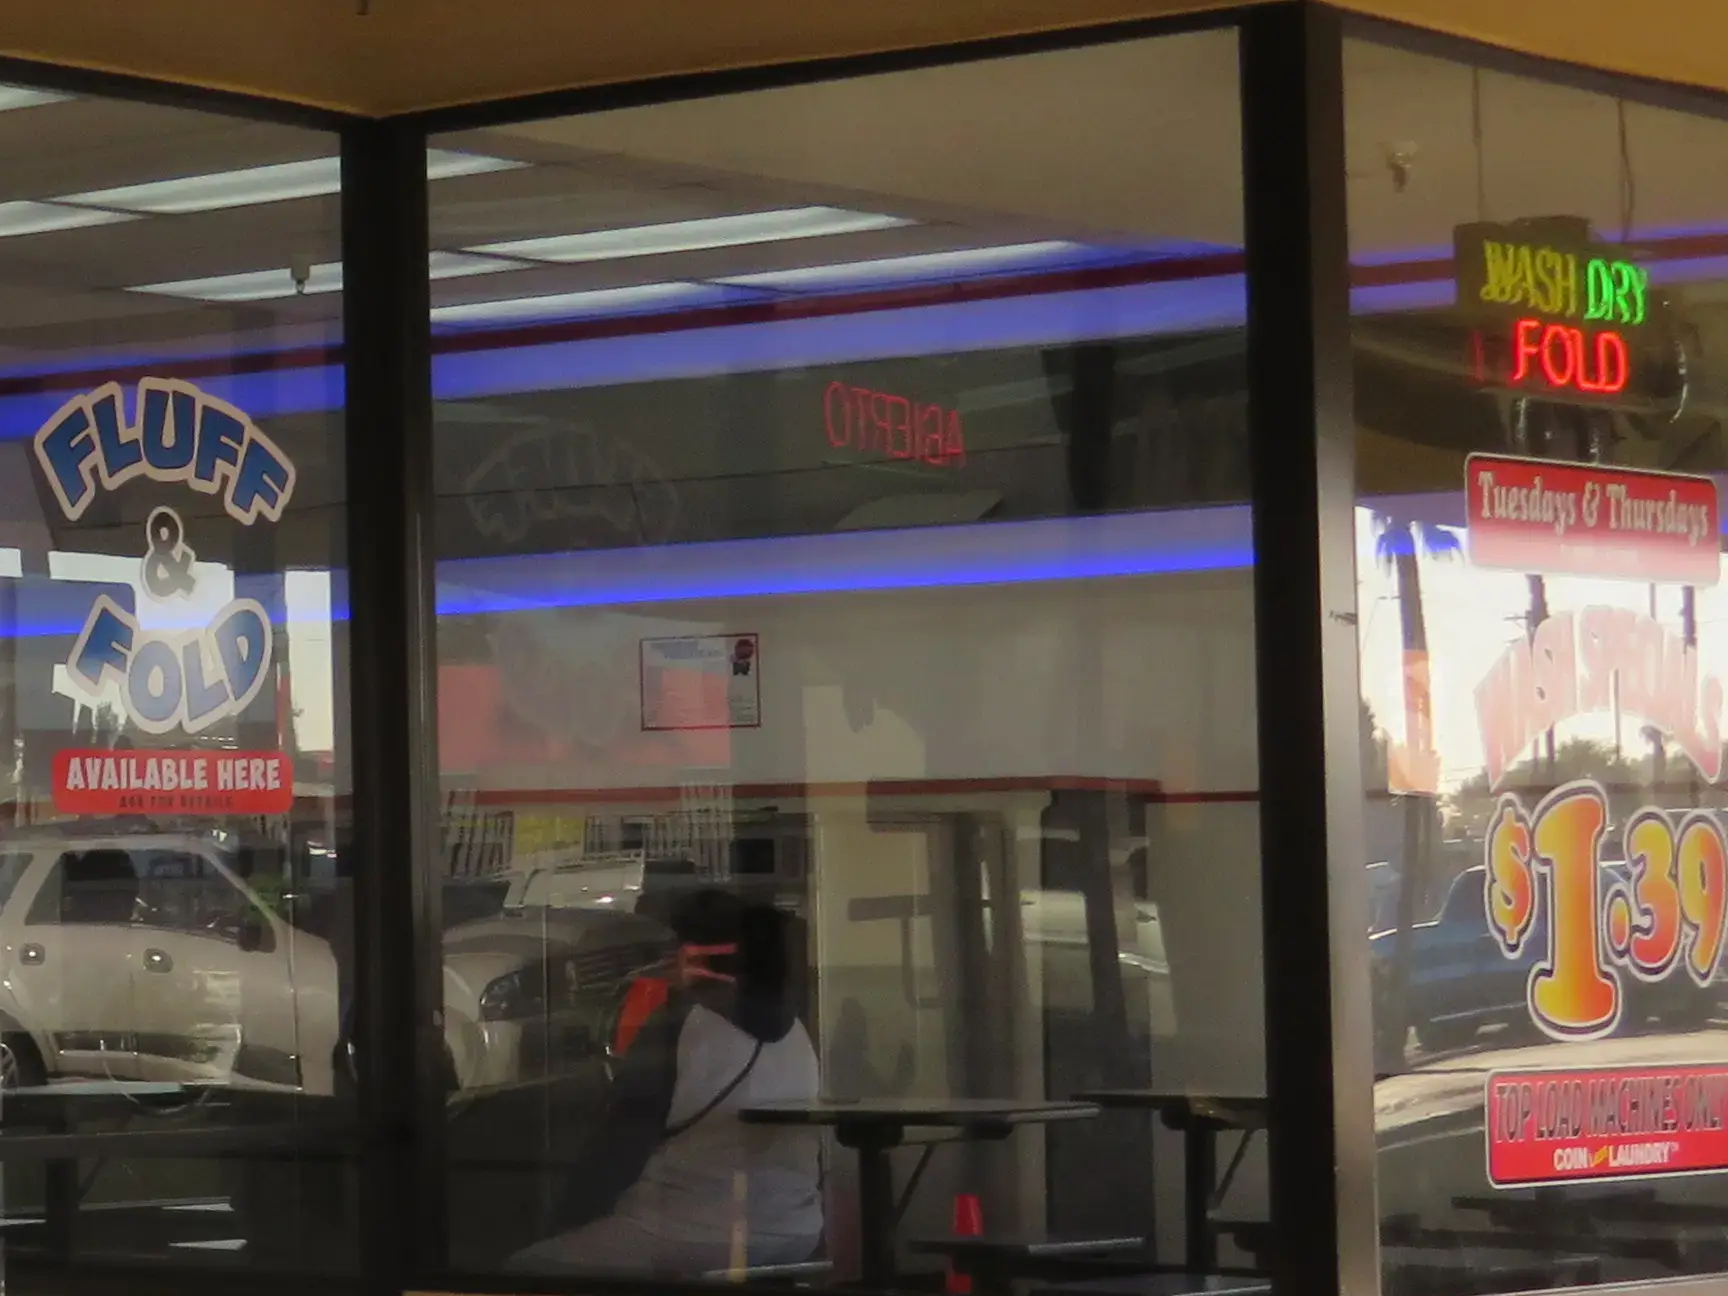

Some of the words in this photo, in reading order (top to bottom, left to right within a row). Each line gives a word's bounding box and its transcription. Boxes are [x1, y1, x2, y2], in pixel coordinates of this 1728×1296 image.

[1480, 239, 1577, 317] WASH
[1583, 258, 1648, 325] DRY
[1512, 318, 1629, 393] FOLD
[34, 376, 297, 525] FLUFF
[1477, 470, 1576, 537] Tuesdays
[1582, 481, 1602, 528] &
[1606, 483, 1710, 547] Thursdays
[140, 506, 197, 603] &
[66, 593, 274, 734] FOLD
[66, 757, 208, 791] AVAILABLE
[217, 758, 281, 792] HERE
[1485, 780, 1727, 1041] $1.39
[1495, 1082, 1533, 1144] TOP
[1534, 1080, 1584, 1140] LOAD
[1586, 1075, 1681, 1138] MACHINES
[1553, 1147, 1588, 1171] COIN
[1608, 1142, 1670, 1168] LAUNDRY
